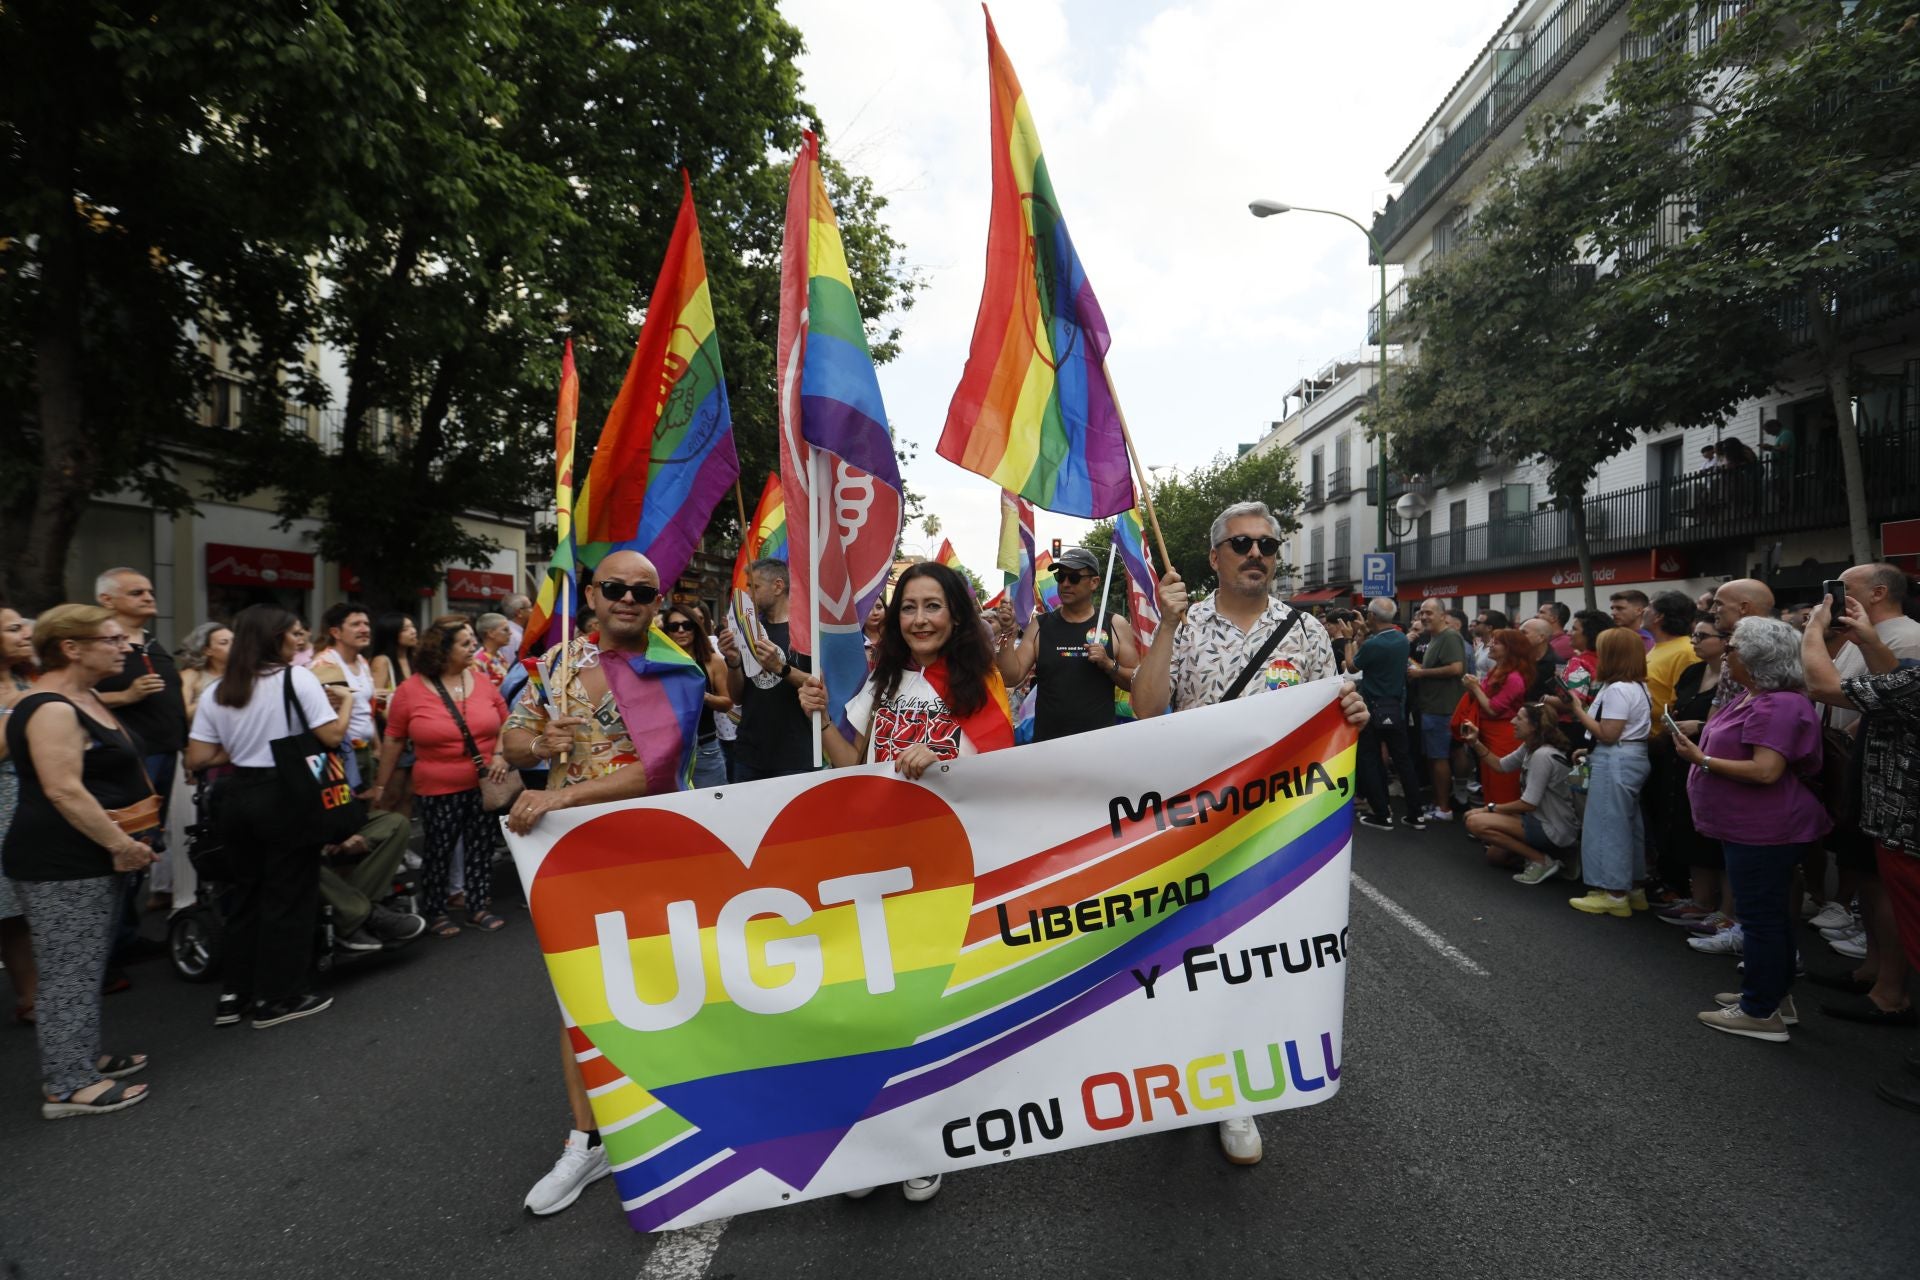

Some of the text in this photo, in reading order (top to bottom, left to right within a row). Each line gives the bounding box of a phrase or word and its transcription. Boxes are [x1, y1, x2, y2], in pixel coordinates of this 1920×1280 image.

[1368, 557, 1386, 581] P
[1564, 567, 1616, 584] Sannder
[1269, 667, 1297, 682] UGT
[996, 872, 1210, 947] LIBERTAD
[594, 866, 914, 1032] UGT
[1131, 964, 1161, 999] Y
[942, 1097, 1064, 1159] CON
